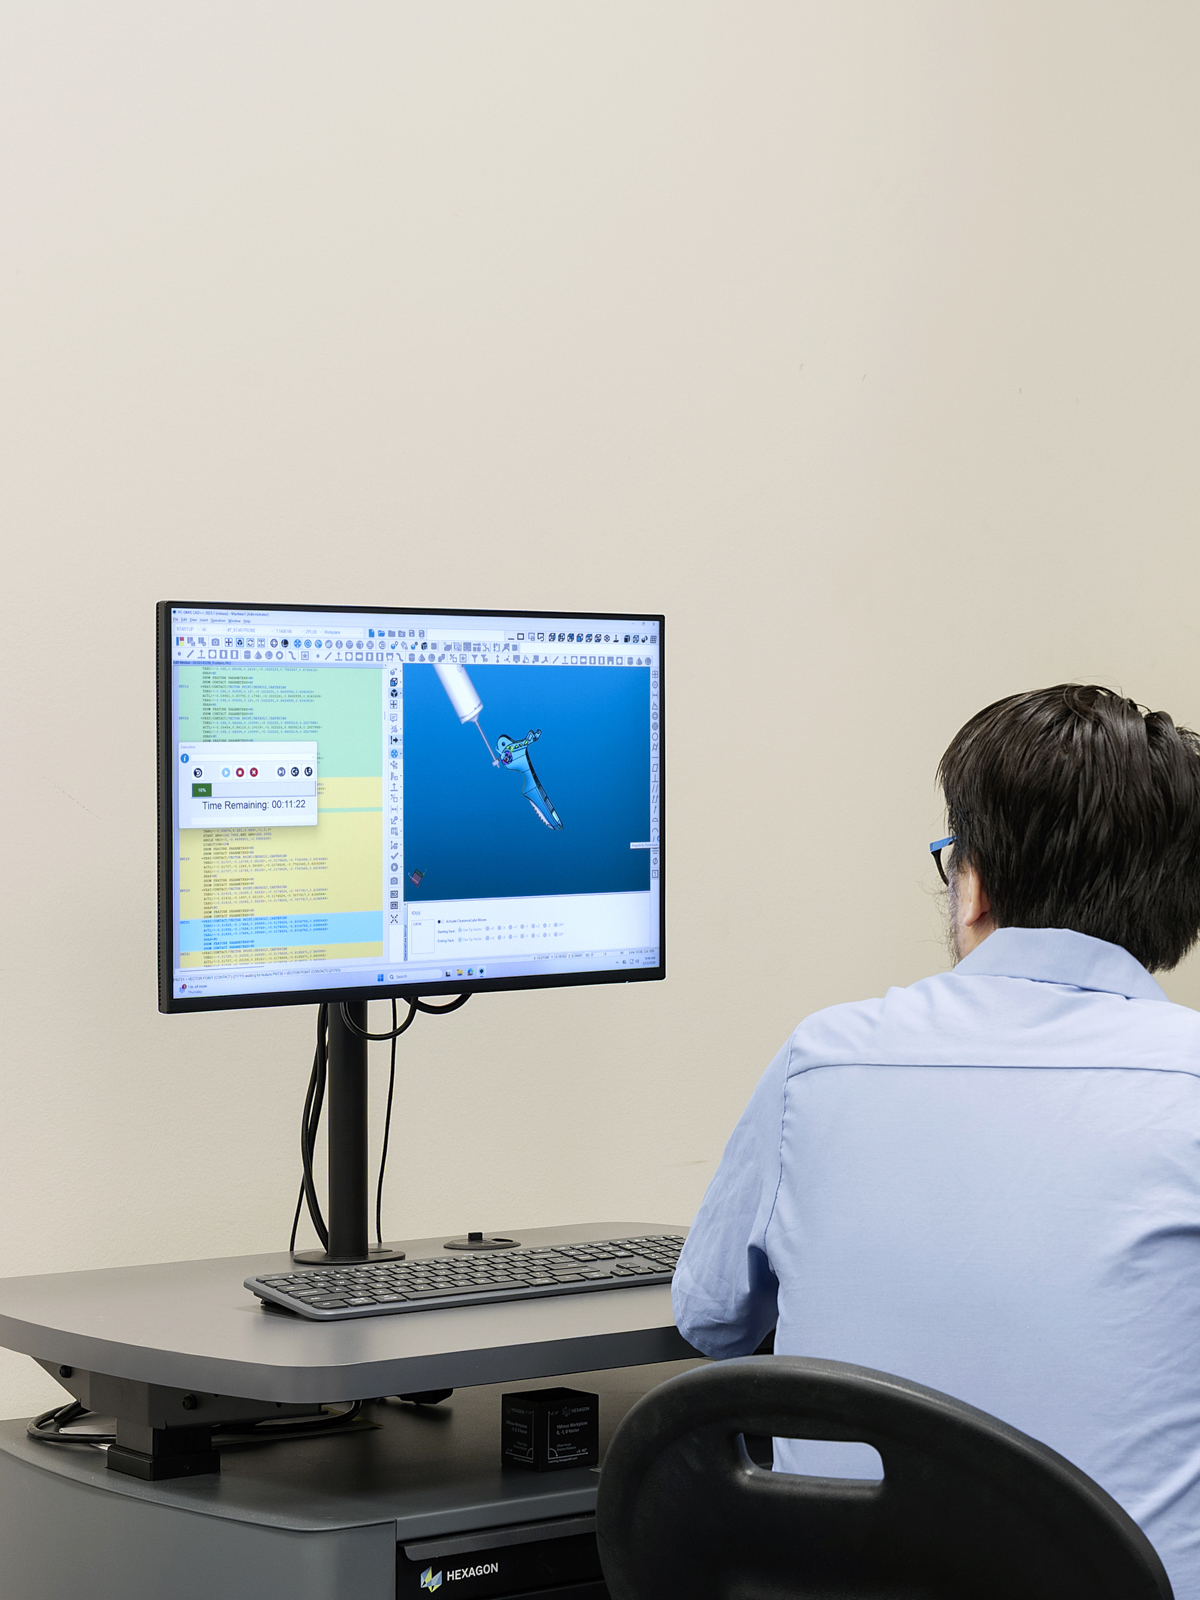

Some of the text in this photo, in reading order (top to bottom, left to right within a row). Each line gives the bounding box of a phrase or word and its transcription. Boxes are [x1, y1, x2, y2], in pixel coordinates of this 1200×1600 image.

[202, 800, 306, 811] Time Remaining: 00:11:22
[446, 1562, 499, 1581] HEXAGON
